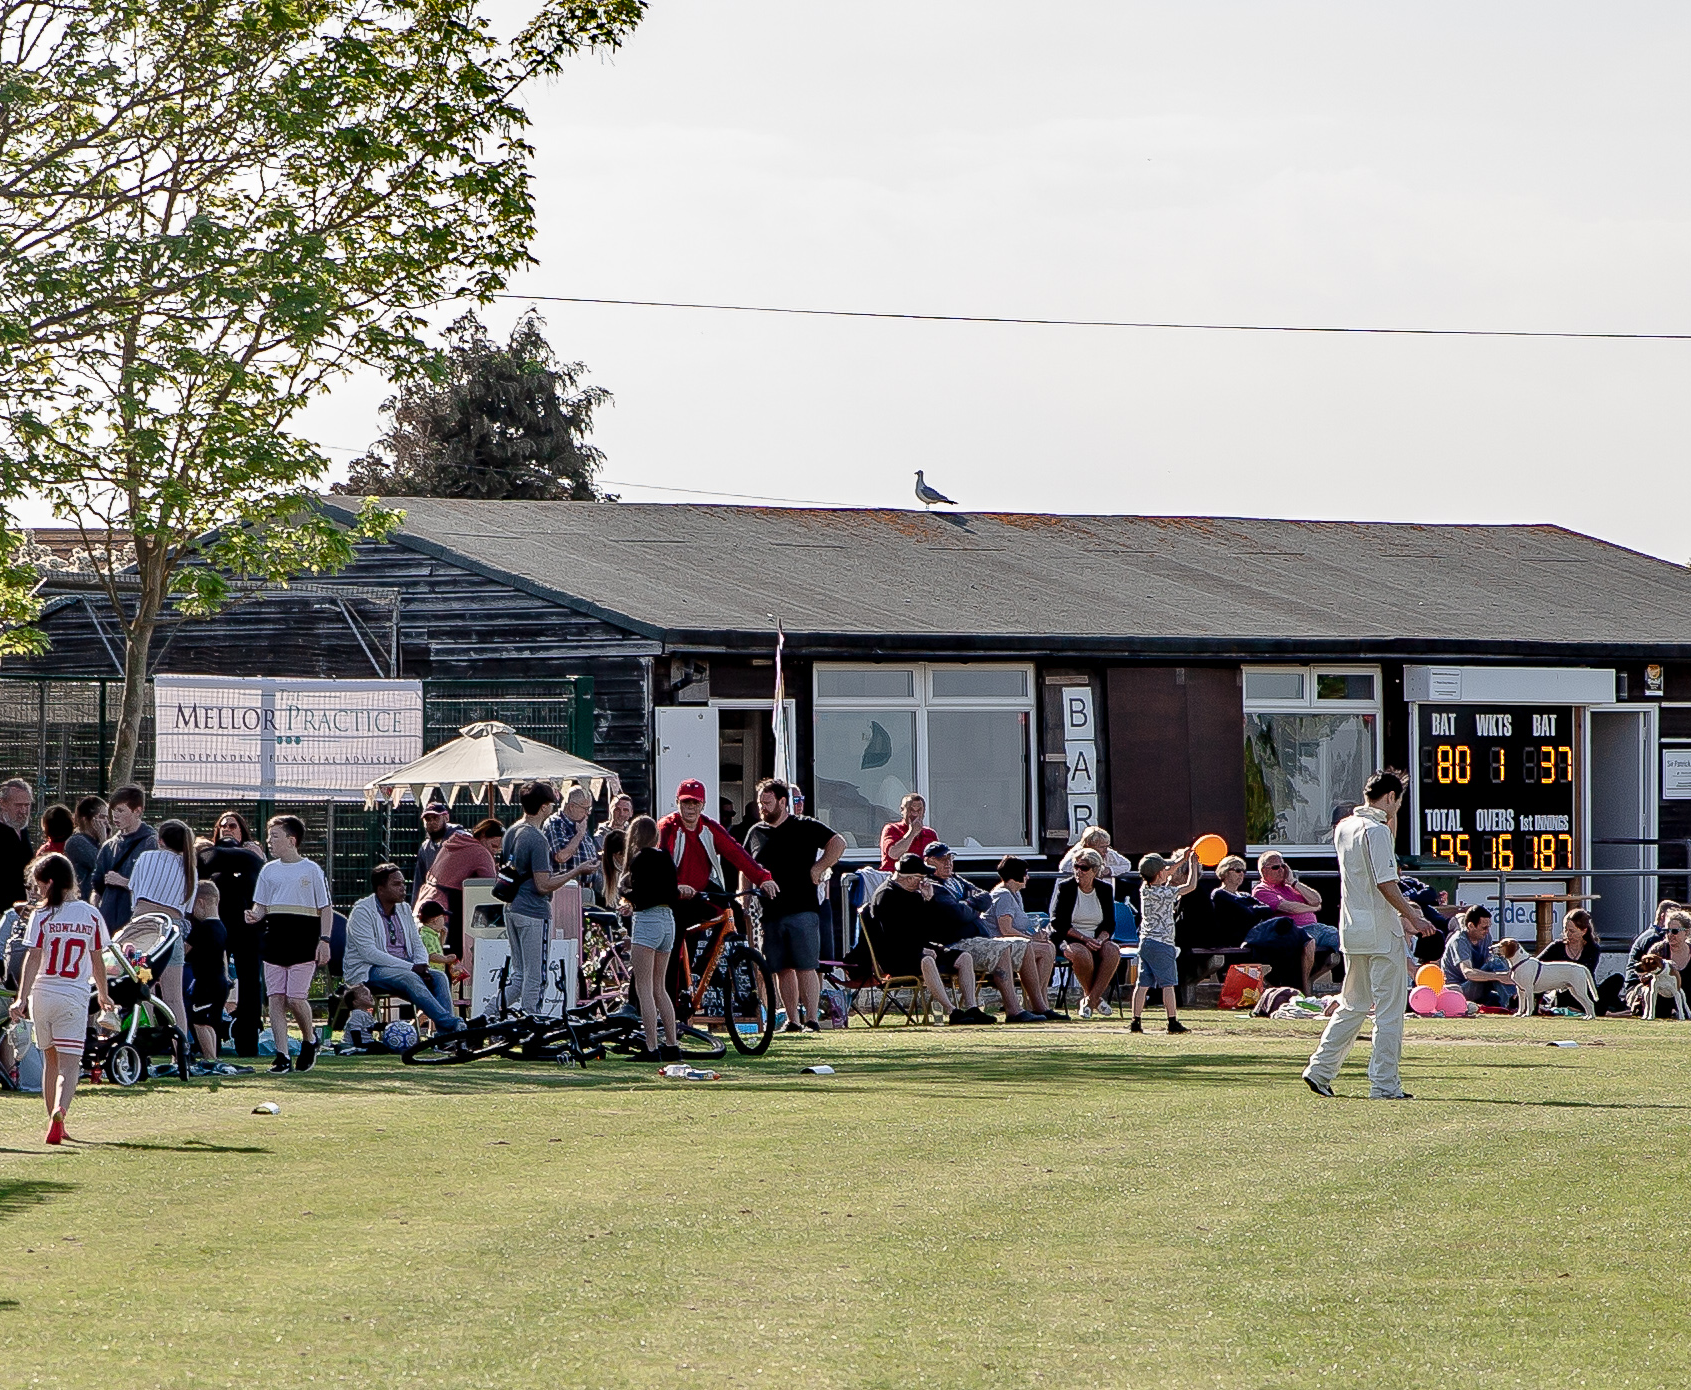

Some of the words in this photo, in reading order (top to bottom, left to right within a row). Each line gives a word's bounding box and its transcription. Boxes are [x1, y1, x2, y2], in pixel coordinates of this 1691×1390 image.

[174, 702, 279, 731] MELLOR
[287, 704, 403, 733] PRACTICE
[1431, 712, 1457, 736] BAT
[1475, 713, 1513, 737] WKTS
[1532, 714, 1558, 737] BAT
[174, 754, 261, 763] INDEPENDENT
[269, 755, 338, 764] FINANCIAL
[344, 757, 404, 765] ADVISERS
[1068, 697, 1093, 835] BAR
[1437, 745, 1471, 784] 80
[1540, 745, 1573, 784] 37
[1424, 808, 1464, 832] TOTAL
[1475, 808, 1515, 832] OVERS
[1519, 814, 1534, 831] 1st
[1534, 814, 1570, 832] INNINGS
[1492, 833, 1514, 872] 16
[1533, 833, 1573, 872] 187
[48, 922, 94, 936] ROWLAND
[45, 936, 86, 980] 10
